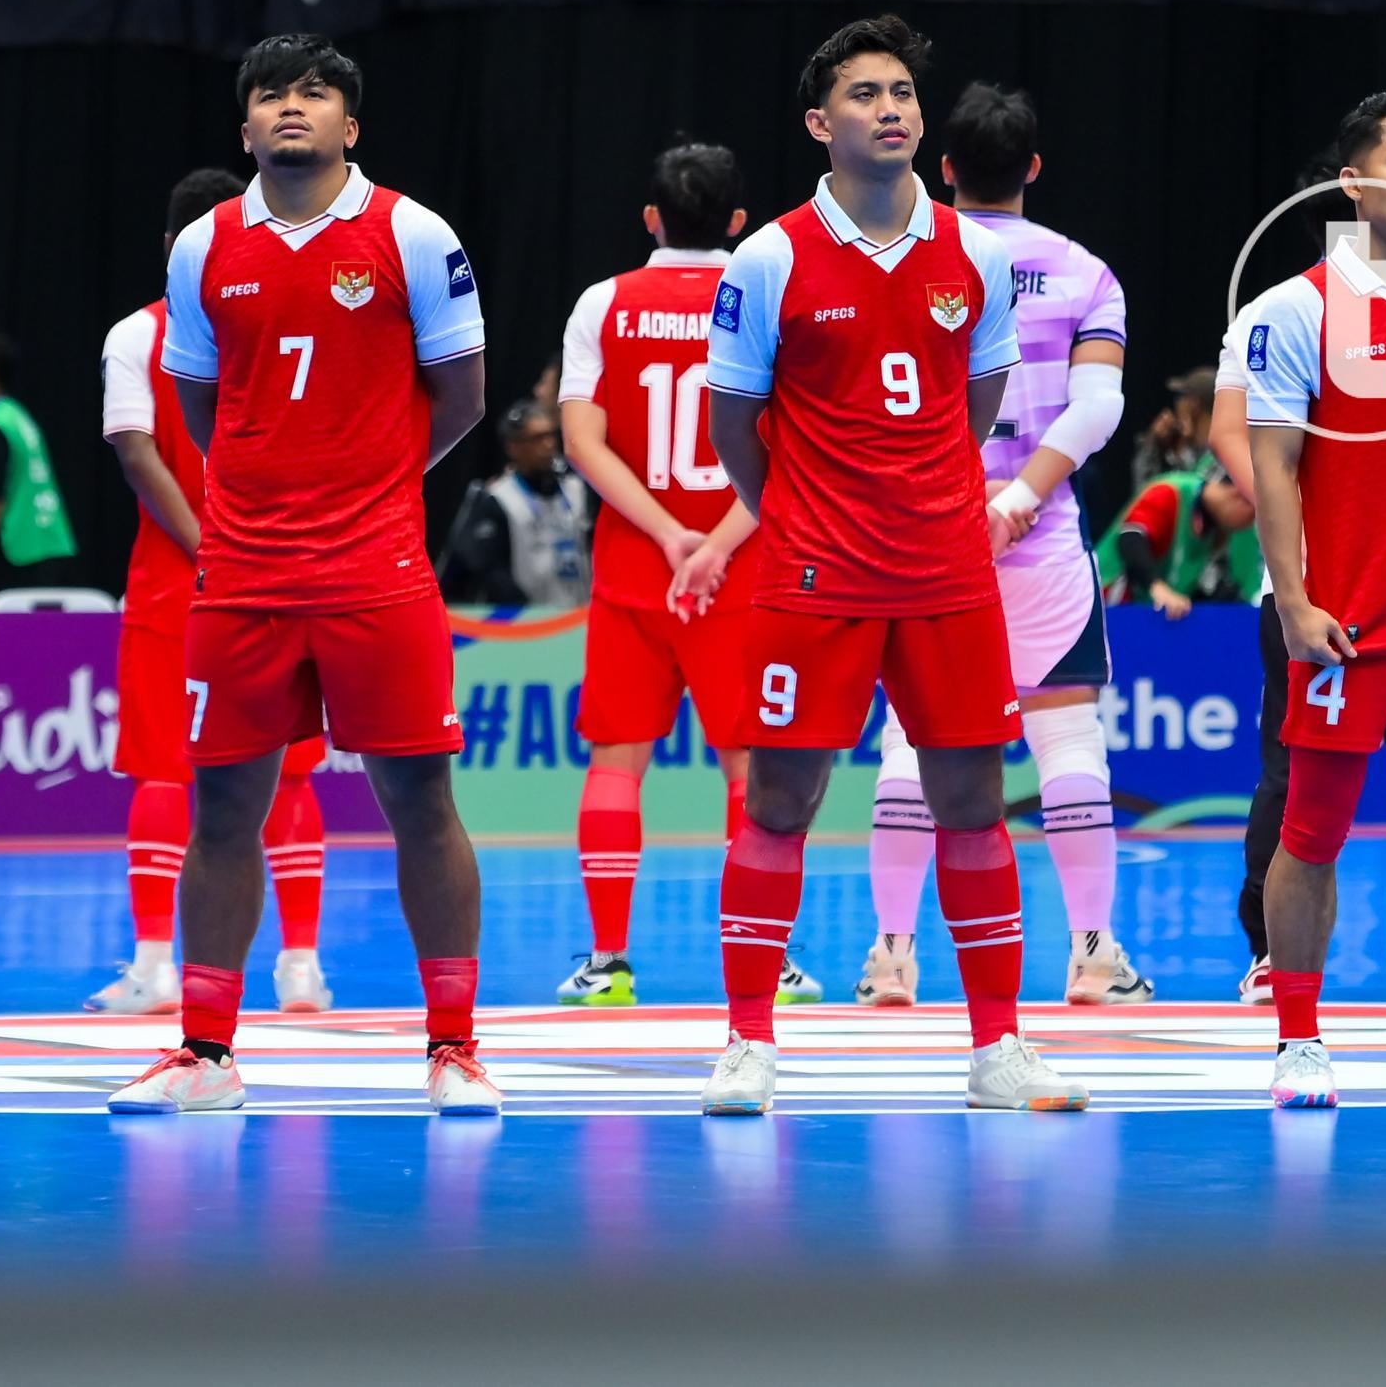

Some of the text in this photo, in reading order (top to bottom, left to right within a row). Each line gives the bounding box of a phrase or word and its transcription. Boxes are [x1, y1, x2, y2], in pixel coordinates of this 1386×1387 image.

[220, 281, 260, 298] SPECS
[814, 306, 856, 323] SPECS
[279, 336, 314, 400] 7
[1344, 342, 1386, 360] SPECS
[880, 352, 921, 416] 9
[639, 362, 732, 491] 10
[185, 677, 210, 743] 7
[758, 662, 798, 727] 9
[1306, 664, 1346, 725] 4
